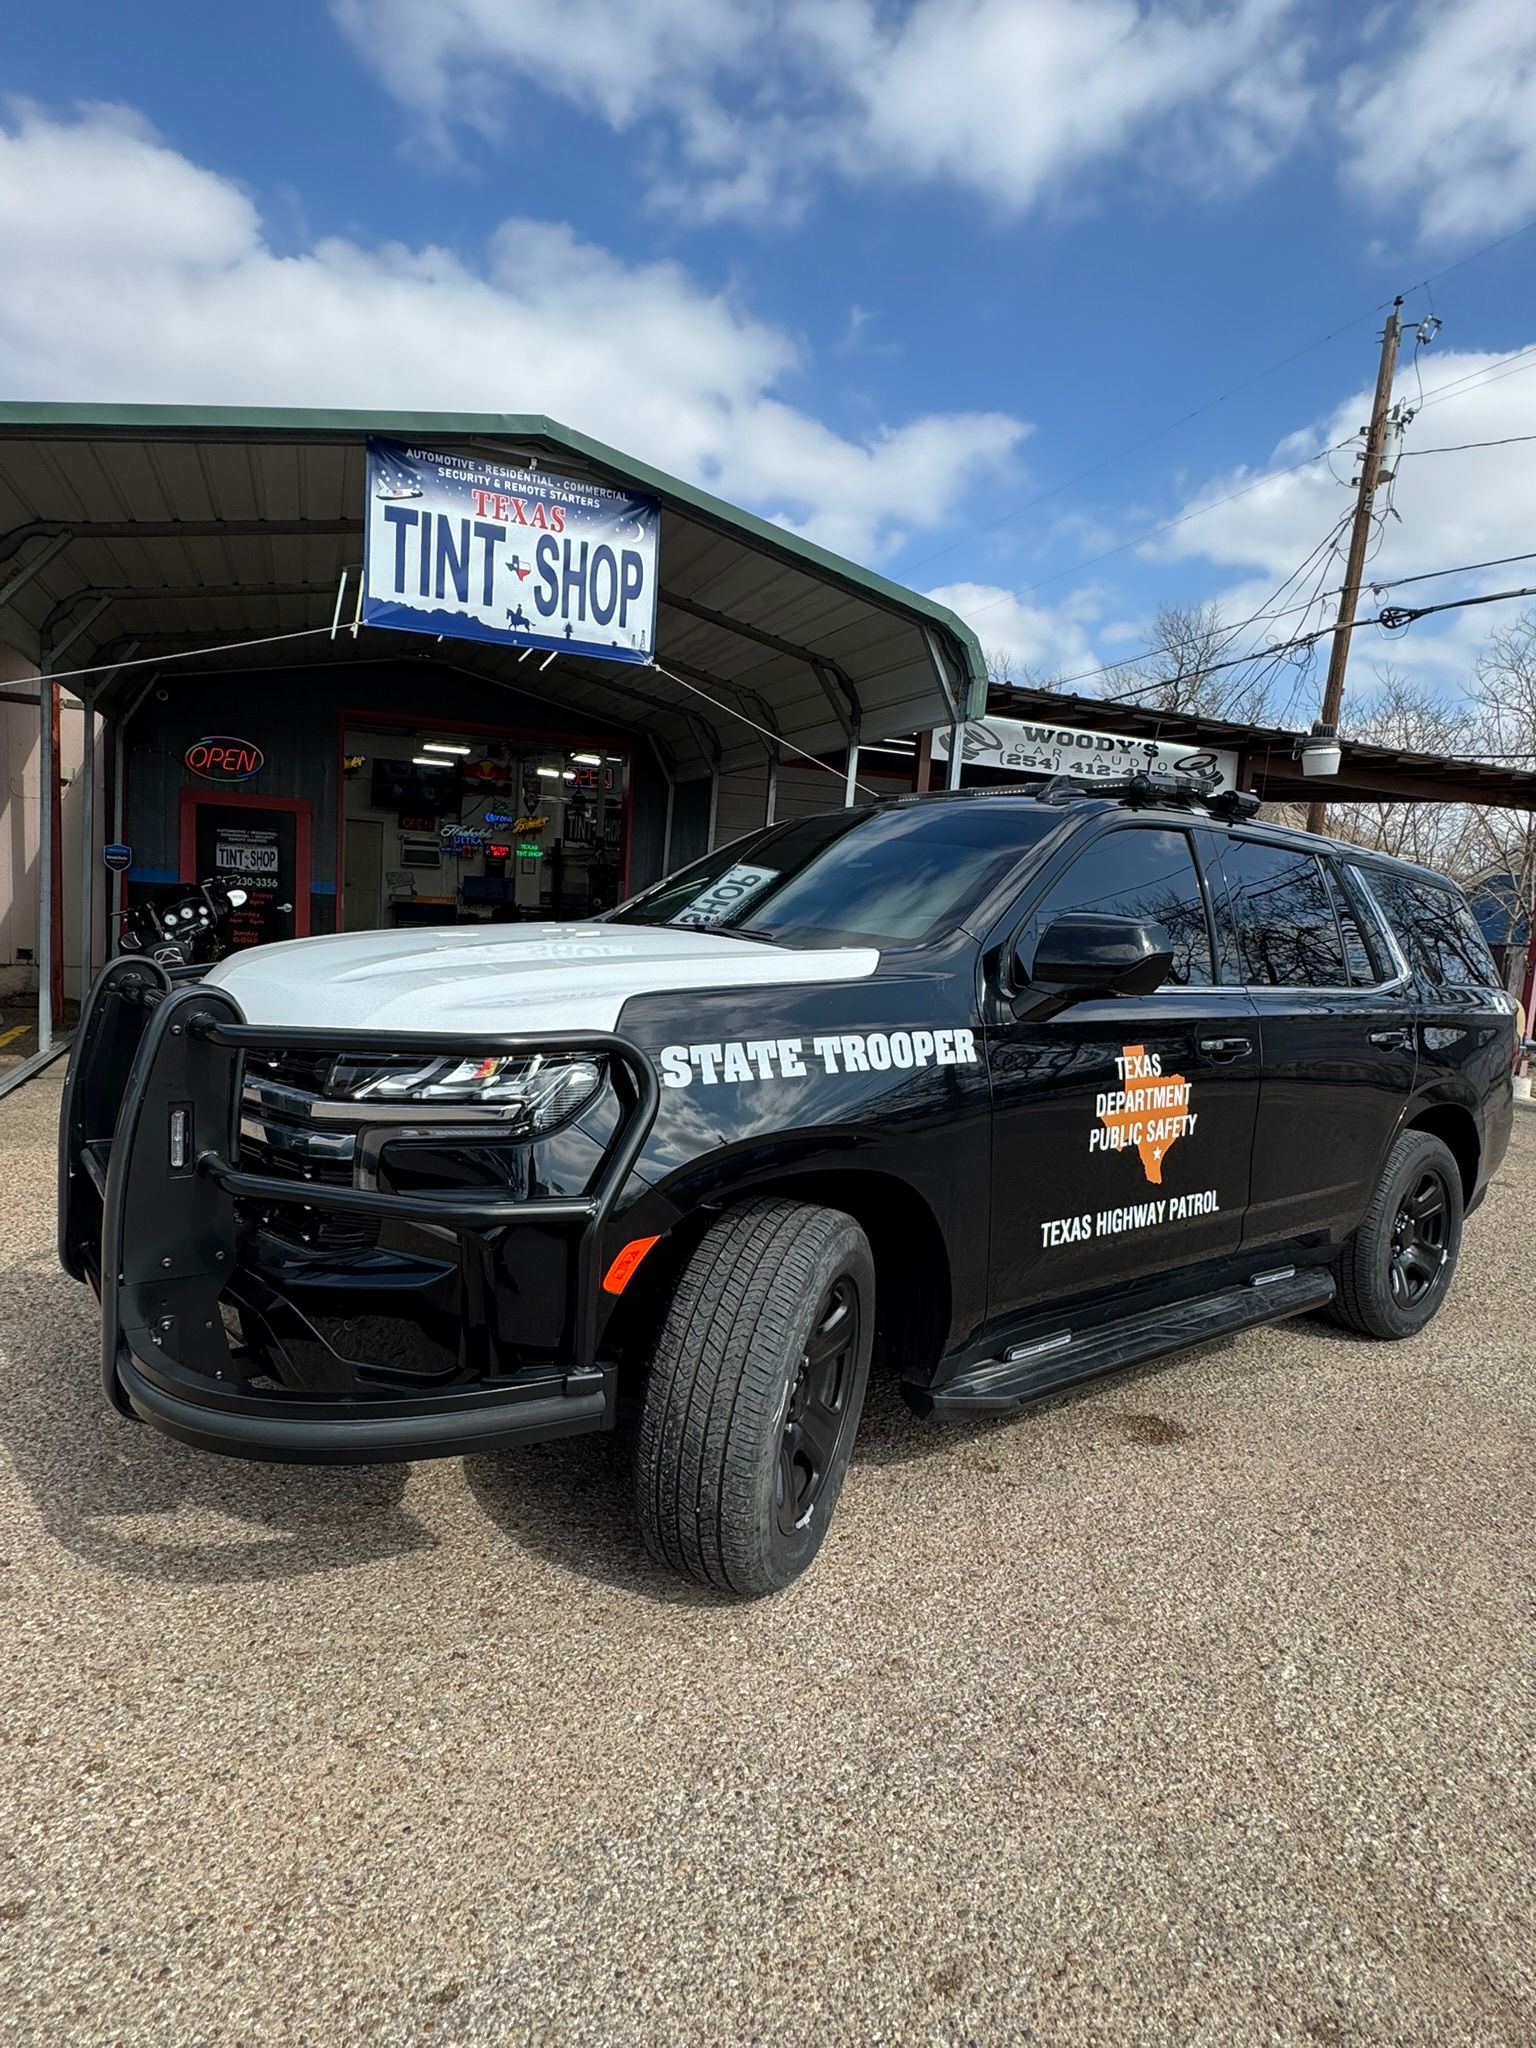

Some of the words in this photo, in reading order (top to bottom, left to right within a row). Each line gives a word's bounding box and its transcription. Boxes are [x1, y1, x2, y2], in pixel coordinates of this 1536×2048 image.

[406, 448, 475, 471] AUTOMOTIVE
[485, 464, 553, 488] RESIDENTIAL
[563, 480, 628, 502] COMMERCIAL
[438, 467, 491, 486] SECURITY
[493, 477, 501, 488] &
[504, 480, 546, 498] REMOTE
[549, 489, 600, 508] STARTERS
[471, 489, 567, 533] TEXAS
[384, 504, 507, 607] TINT
[533, 533, 645, 628] SHOP
[190, 746, 257, 772] OPEN
[1015, 743, 1063, 758] CAR
[1022, 726, 1159, 758] WOODY'S
[1000, 750, 1060, 772] (254)
[219, 848, 244, 866] TINT
[250, 850, 276, 867] SHOP
[660, 1037, 808, 1089] STATE
[813, 1028, 978, 1074] TROOPER
[1115, 1053, 1162, 1080] TEXAS
[1096, 1083, 1192, 1117] DEPARTMENT
[1089, 1121, 1142, 1152] PUBLIC
[1146, 1114, 1198, 1142] SAFETY
[1041, 1214, 1091, 1247] TEXAS
[1096, 1200, 1166, 1236] HIGHWAY
[1169, 1190, 1220, 1220] PATROL
